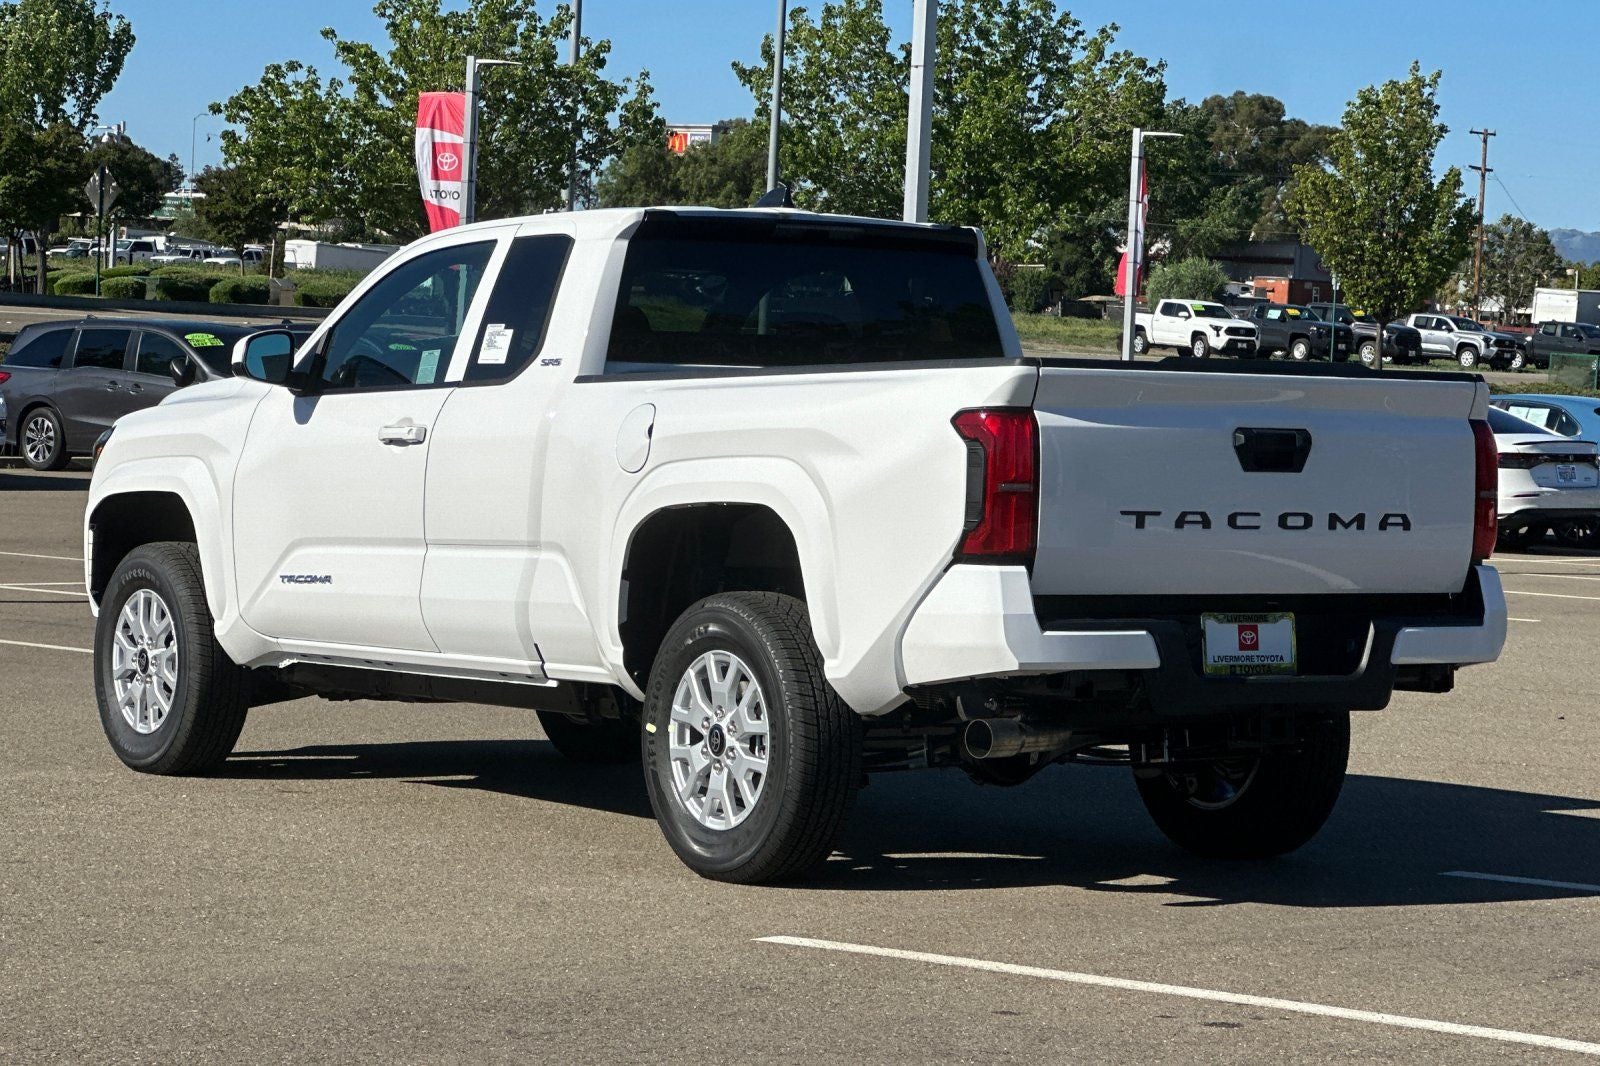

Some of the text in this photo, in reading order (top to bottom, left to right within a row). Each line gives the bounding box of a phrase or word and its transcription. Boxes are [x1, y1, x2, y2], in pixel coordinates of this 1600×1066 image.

[541, 358, 562, 367] SR5
[1120, 510, 1411, 531] TACOMA
[279, 574, 332, 585] TACOMA
[1213, 654, 1285, 663] LIVERMORE TOYOTA
[1239, 664, 1273, 674] TOYOTA
